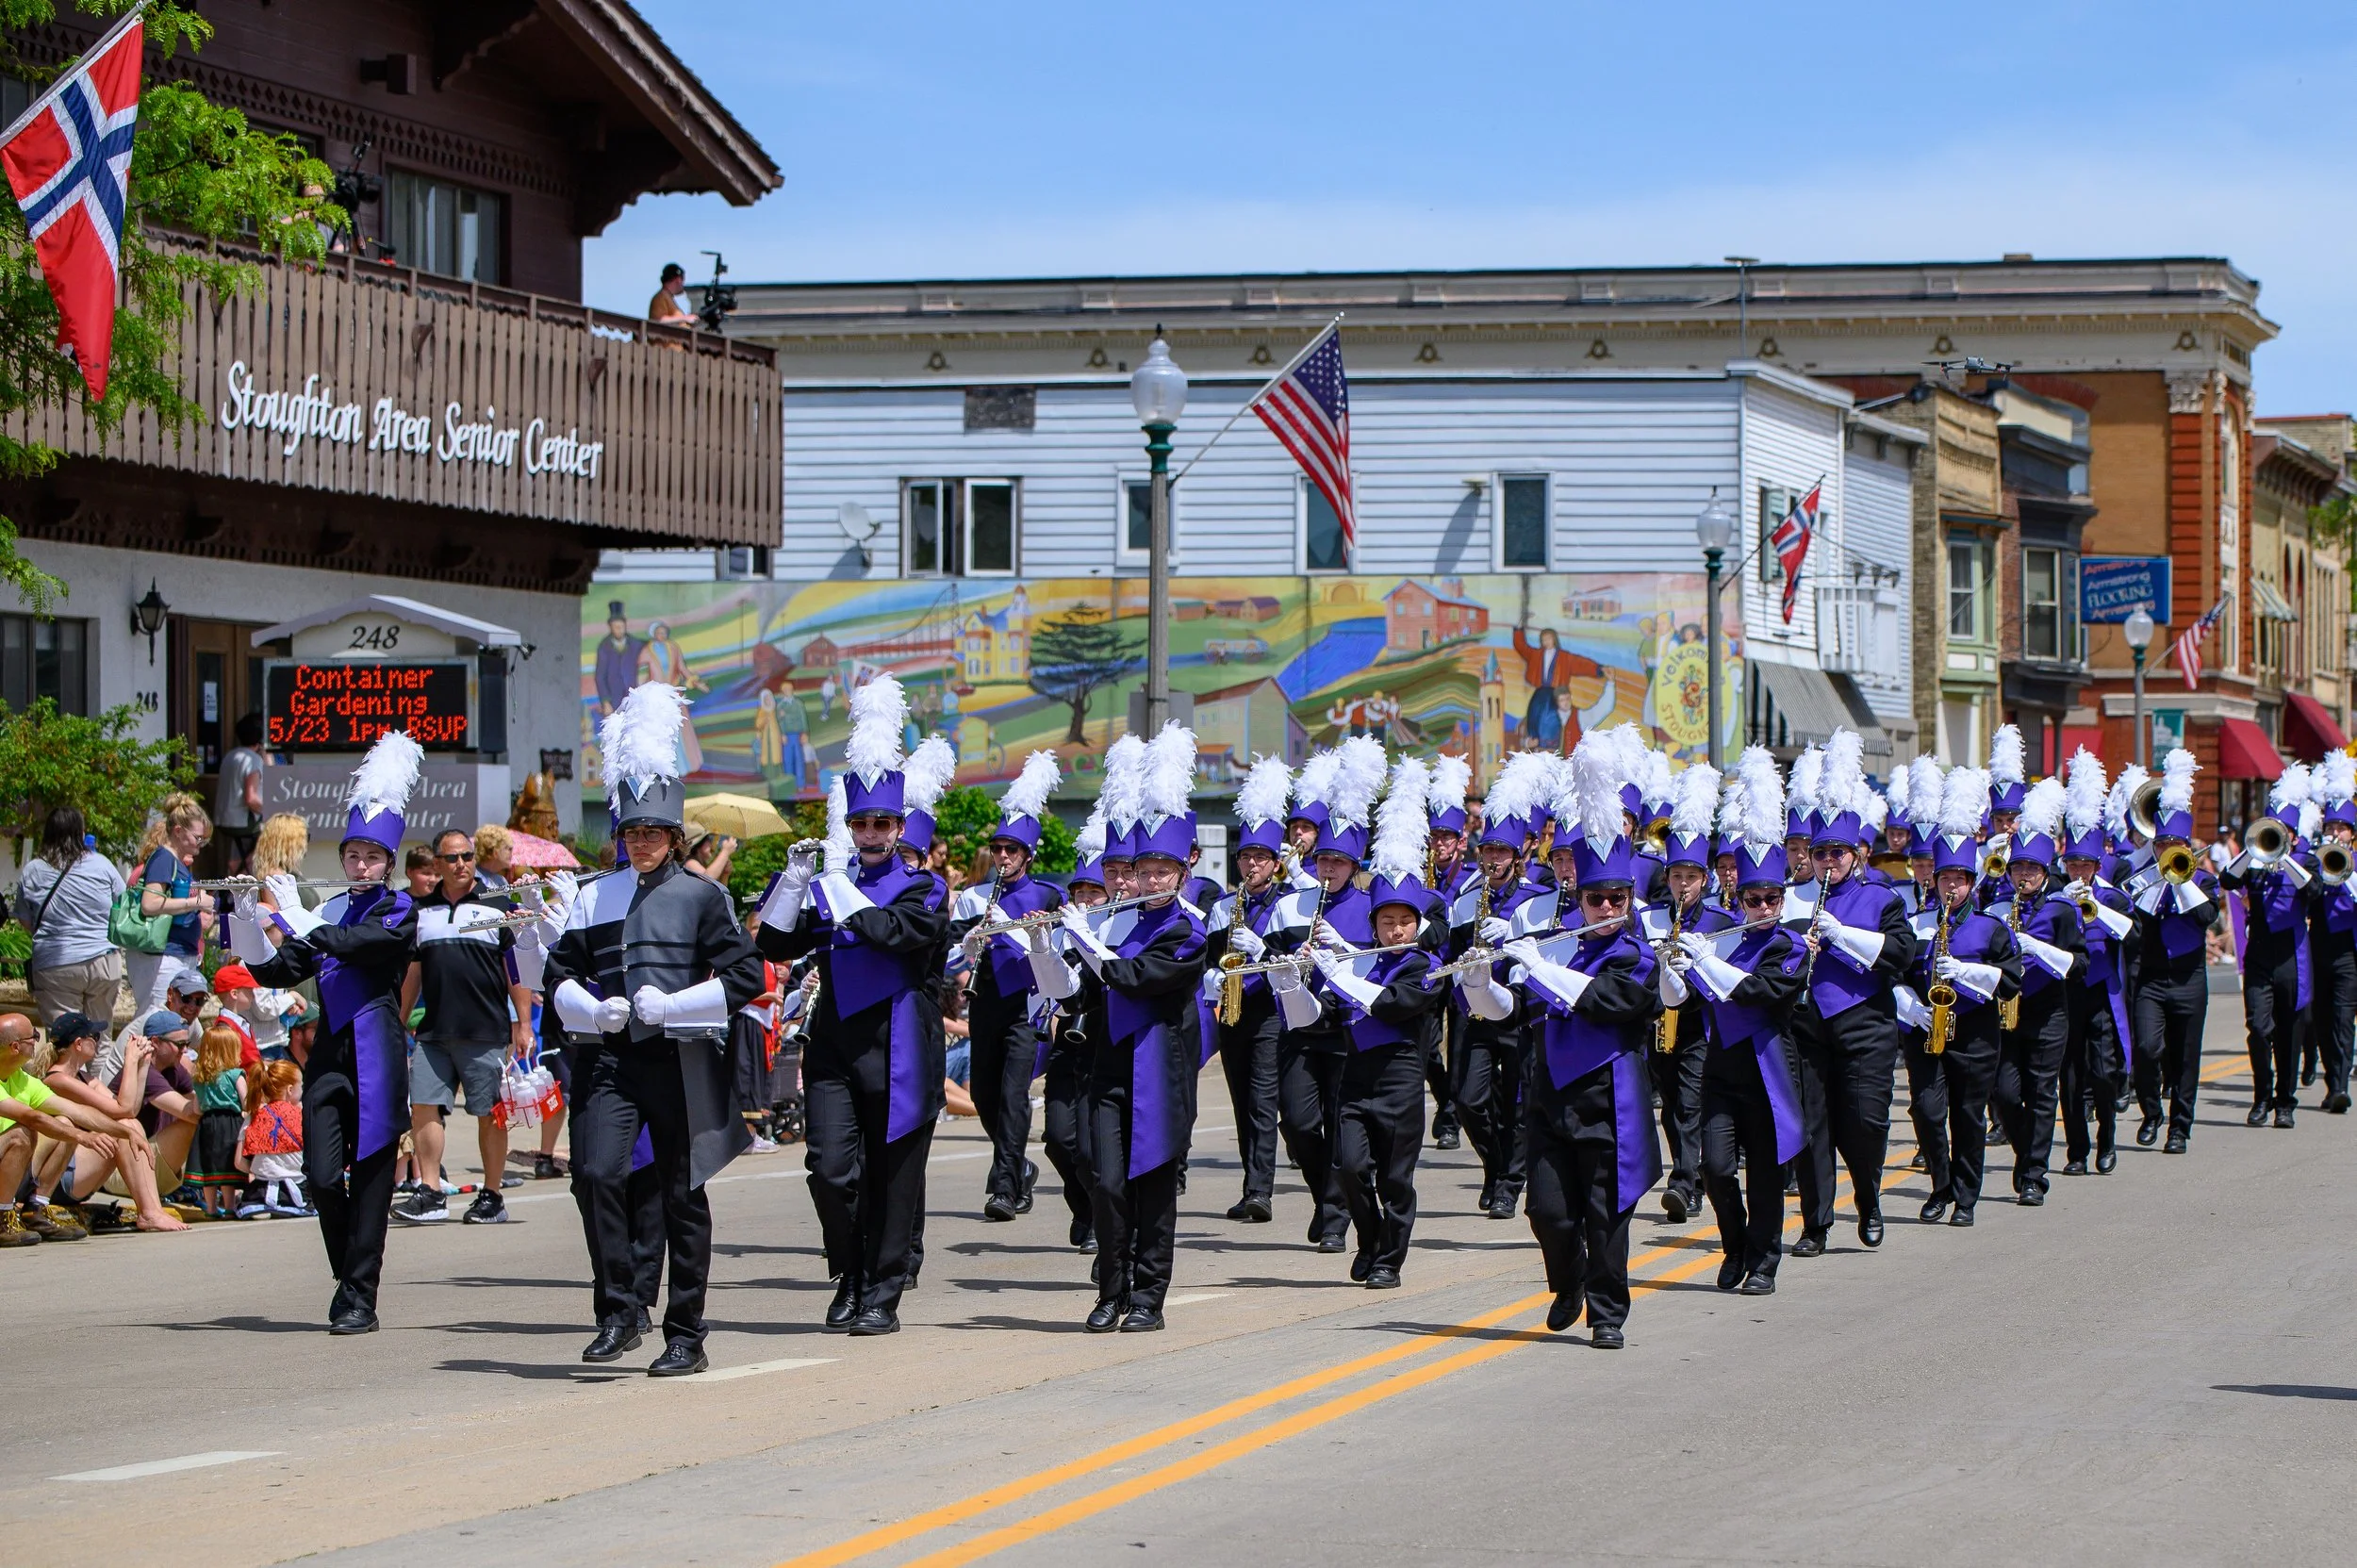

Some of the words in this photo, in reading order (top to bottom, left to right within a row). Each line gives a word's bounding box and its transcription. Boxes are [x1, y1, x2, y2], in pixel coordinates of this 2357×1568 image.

[221, 360, 362, 455] Stoughton
[369, 396, 431, 454] Area
[437, 401, 519, 467] Senior
[524, 417, 603, 479] Center
[2086, 571, 2151, 591] Armstrong
[2086, 584, 2153, 608] FLOORING
[349, 625, 401, 650] 248
[296, 664, 434, 690] Container
[289, 690, 428, 716] Gardening
[269, 716, 330, 743] 5/23
[406, 715, 468, 741] RSVP
[409, 776, 467, 799] Area
